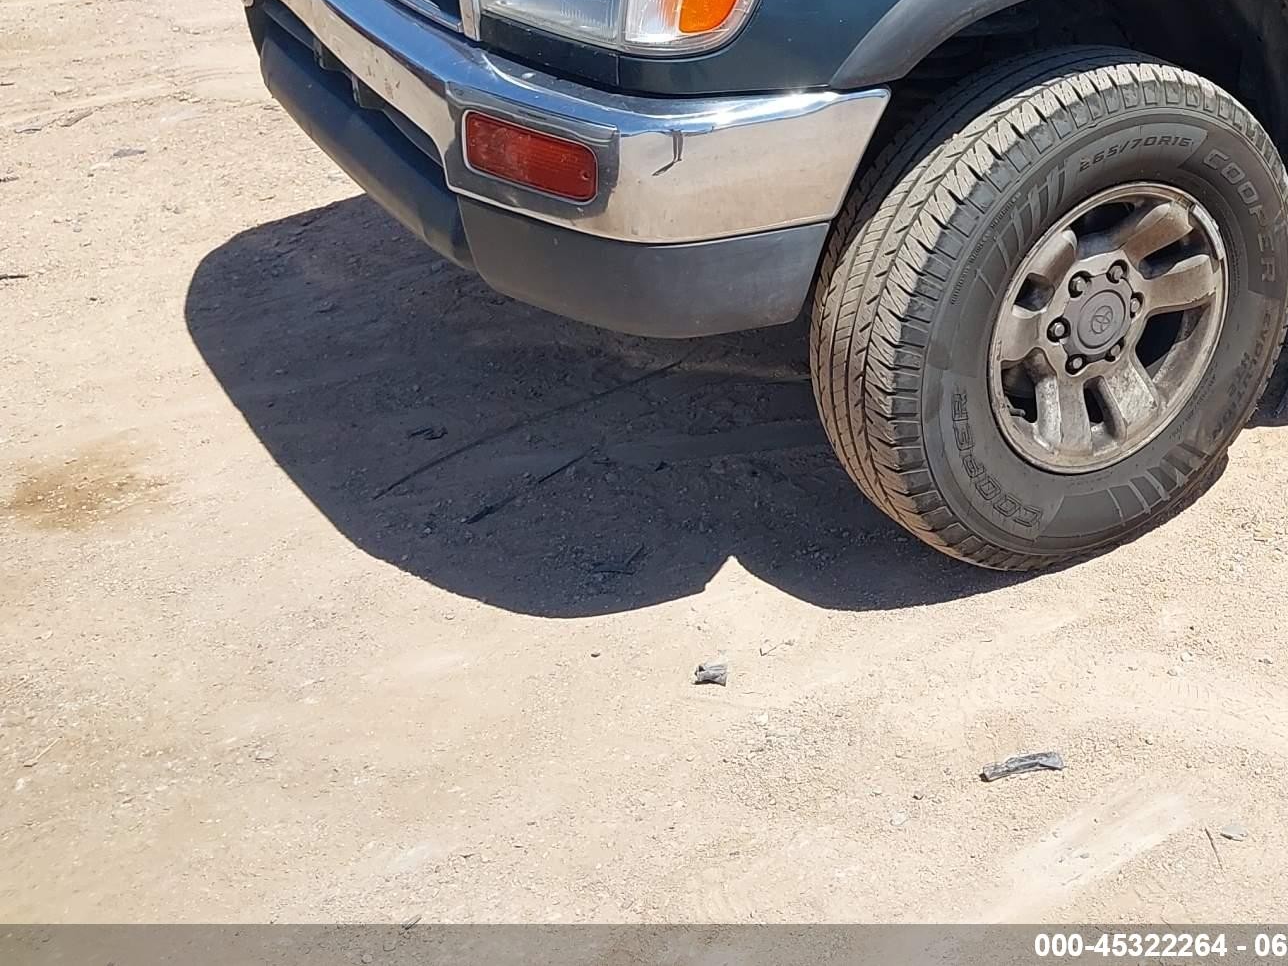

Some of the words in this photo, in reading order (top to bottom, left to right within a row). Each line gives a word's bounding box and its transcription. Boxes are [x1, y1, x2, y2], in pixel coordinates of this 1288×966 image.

[1079, 136, 1192, 171] 265/70R16
[1203, 149, 1276, 282] COOPER
[952, 391, 1043, 528] COOPER
